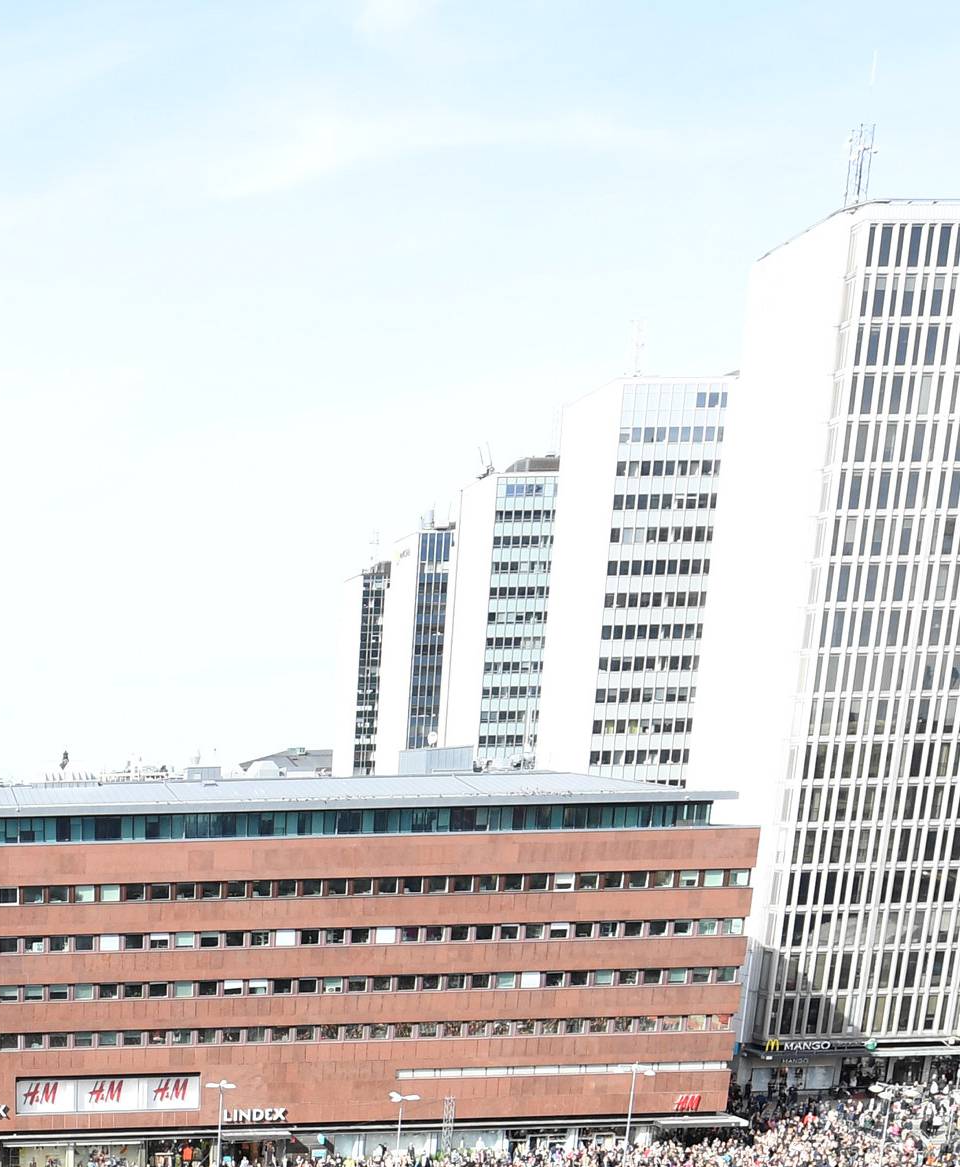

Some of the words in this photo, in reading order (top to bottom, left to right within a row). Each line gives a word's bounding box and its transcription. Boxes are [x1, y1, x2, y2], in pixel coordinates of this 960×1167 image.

[784, 1041, 831, 1051] MANGO
[23, 1081, 58, 1105] H&M
[88, 1079, 124, 1103] H&M
[153, 1078, 188, 1101] H&M
[673, 1094, 701, 1111] H&M
[223, 1108, 287, 1122] LINDEX
